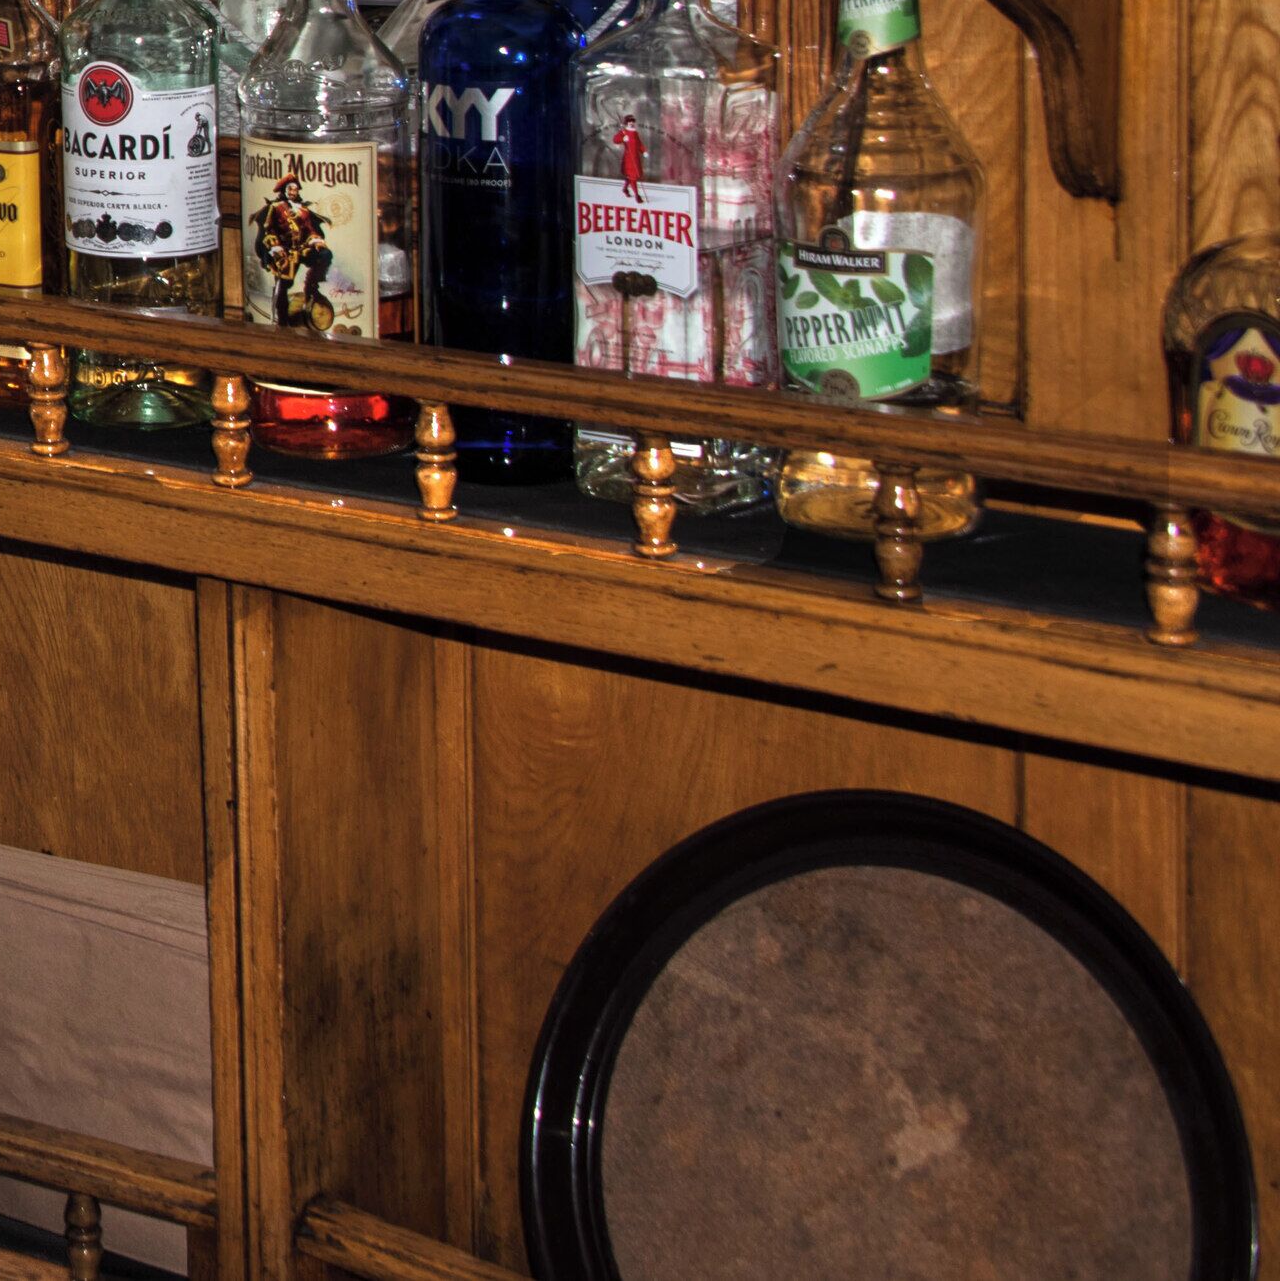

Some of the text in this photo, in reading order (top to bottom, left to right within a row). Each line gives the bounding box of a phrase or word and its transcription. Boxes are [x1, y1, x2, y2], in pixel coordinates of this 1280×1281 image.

[64, 124, 172, 160] BACARDÍ
[74, 167, 147, 181] SUPERIOR
[283, 153, 359, 187] Morgan
[106, 202, 131, 210] CARTA
[577, 202, 694, 248] BEEFEATER
[605, 235, 664, 250] LONDON
[831, 254, 881, 268] WALKER
[785, 303, 906, 348] PEPPERMINT
